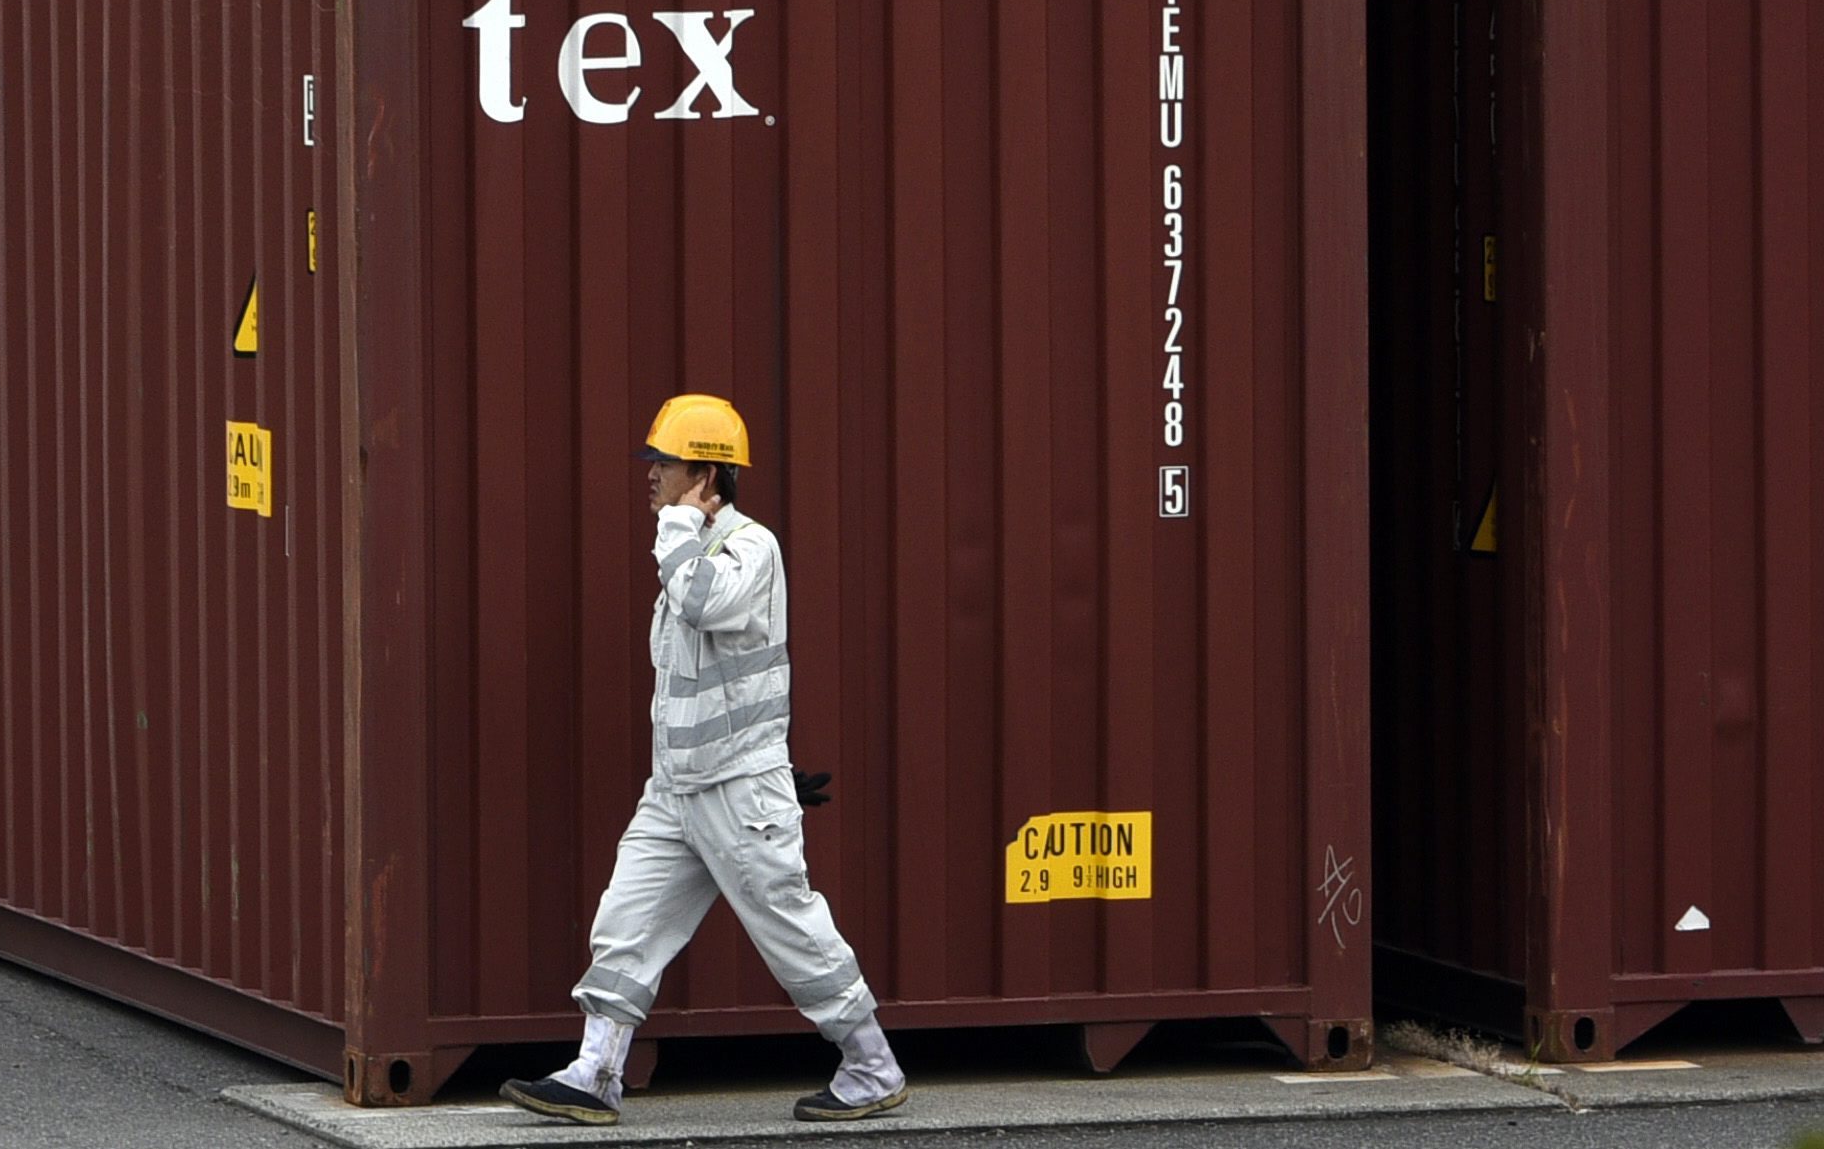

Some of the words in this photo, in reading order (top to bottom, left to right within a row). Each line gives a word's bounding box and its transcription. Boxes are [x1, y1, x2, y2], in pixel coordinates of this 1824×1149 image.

[1163, 164, 1184, 447] 637248
[1164, 470, 1184, 514] 5
[1025, 822, 1133, 860] CAUTION
